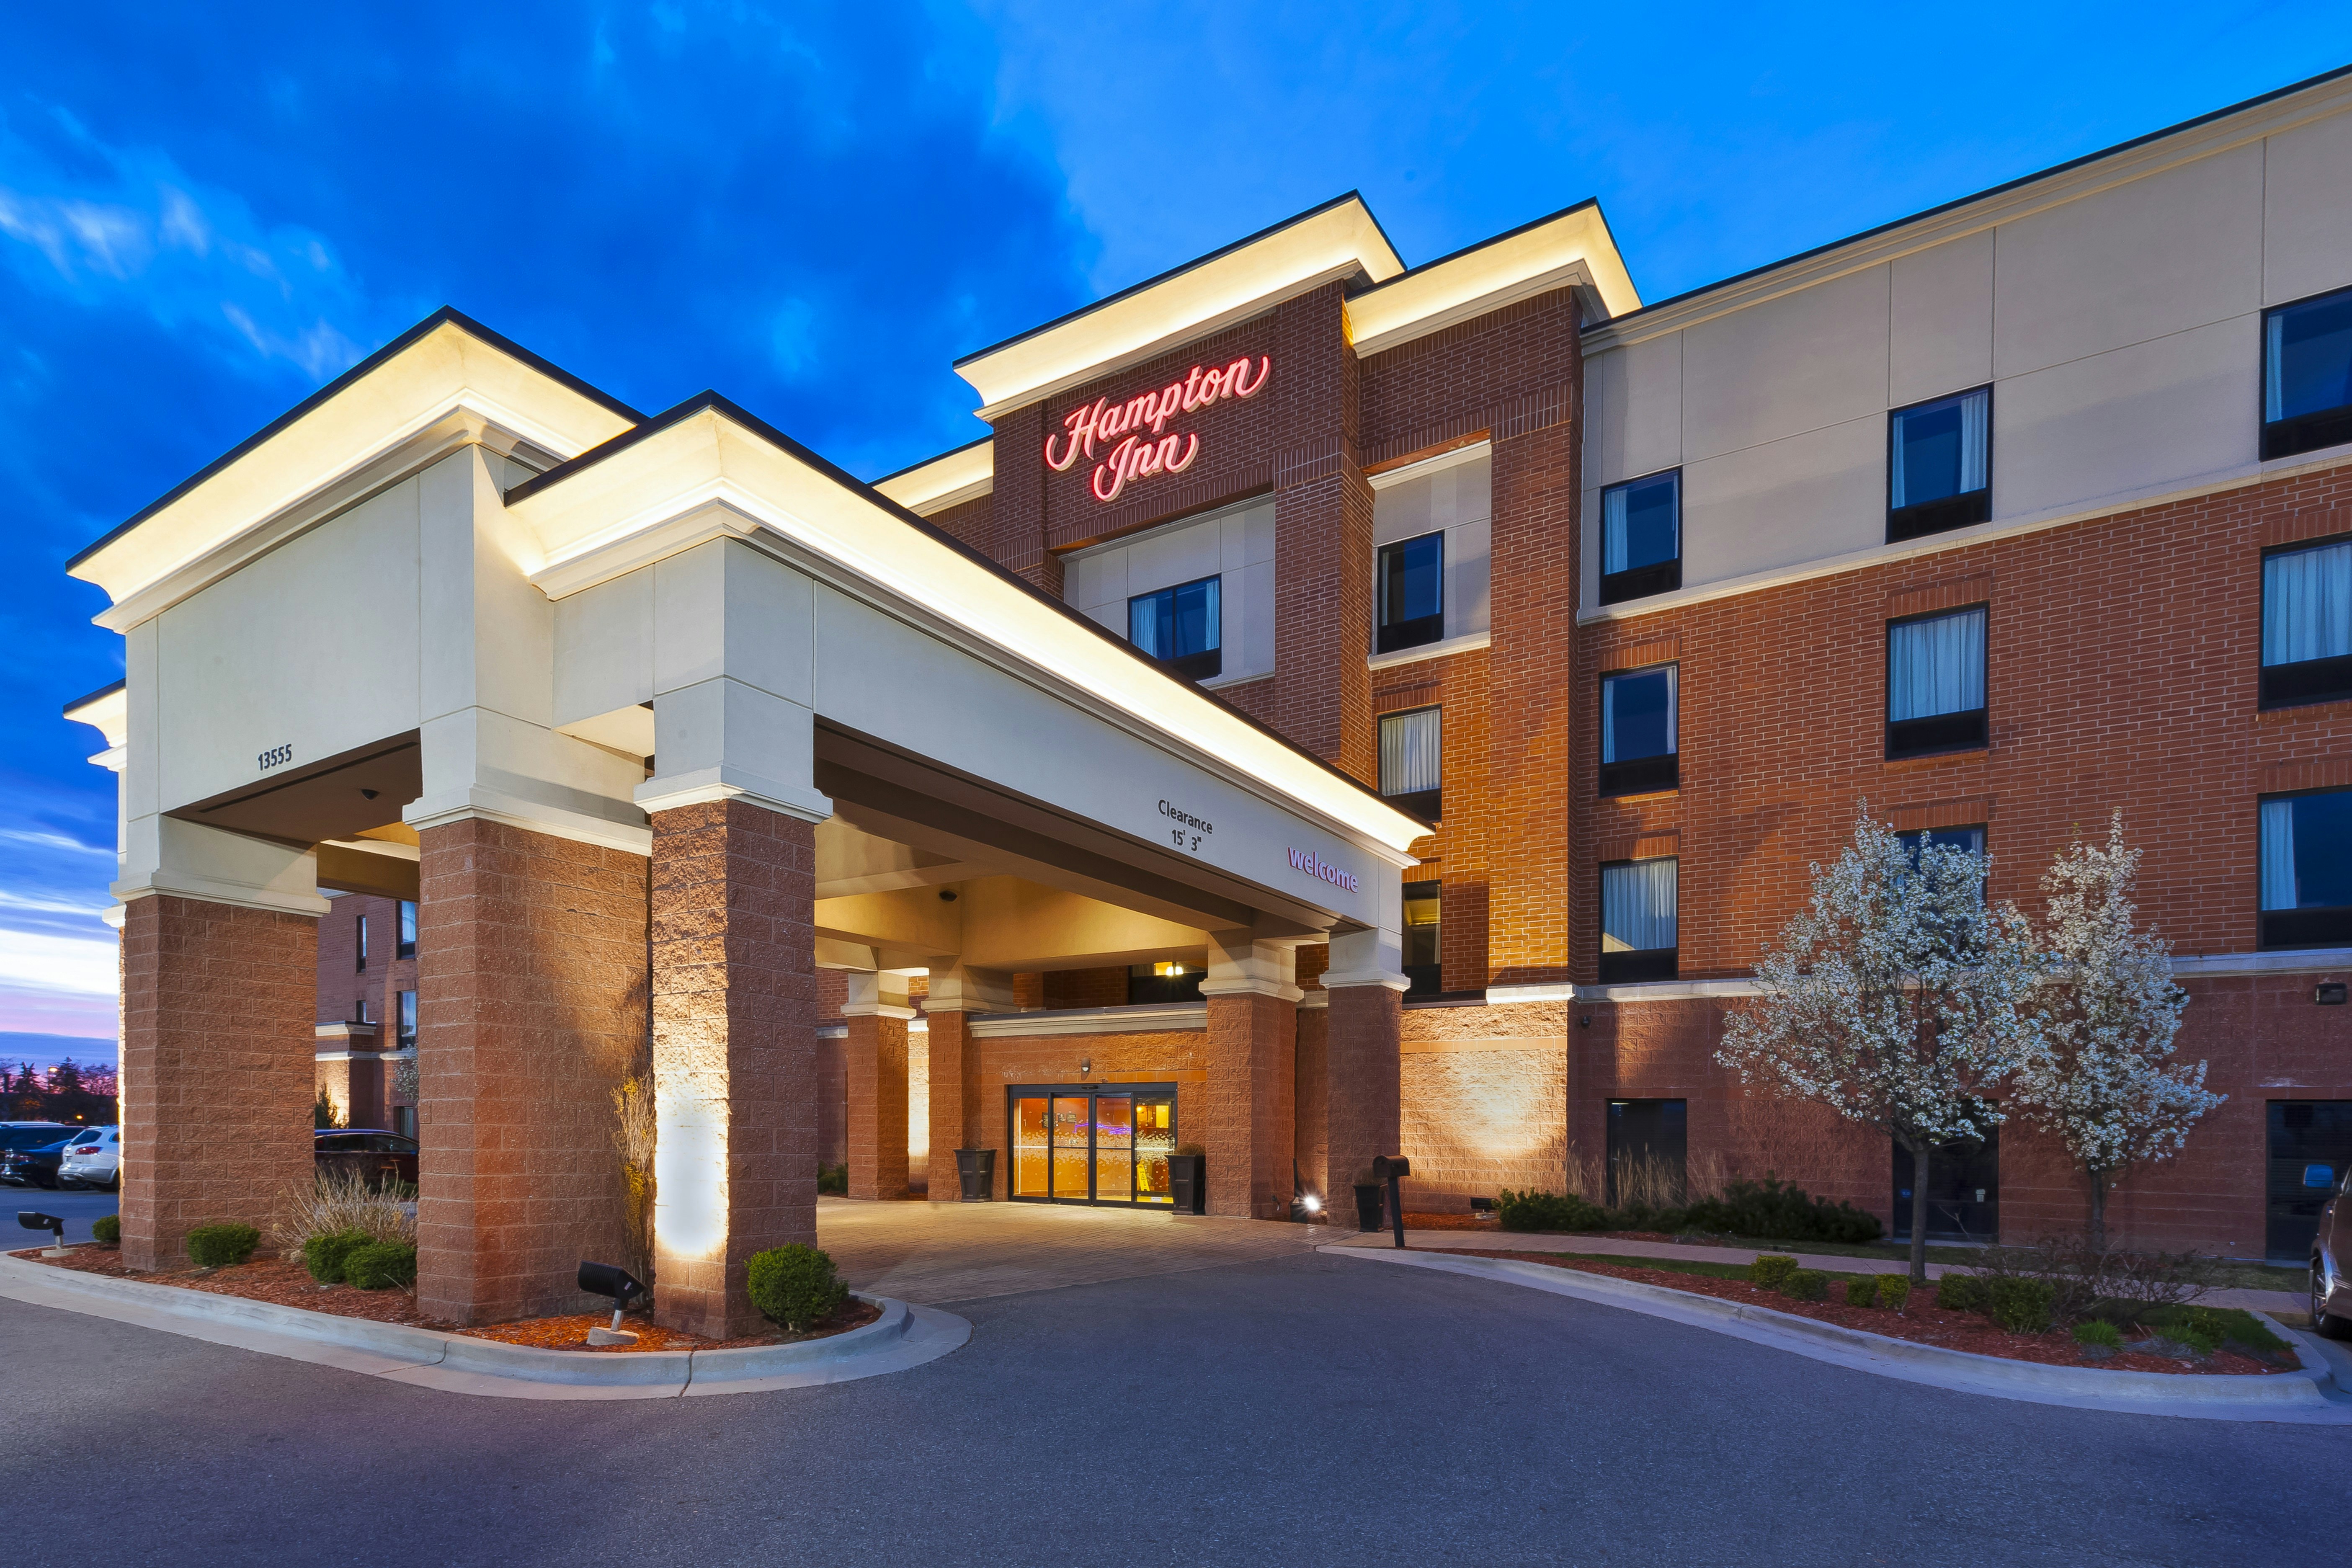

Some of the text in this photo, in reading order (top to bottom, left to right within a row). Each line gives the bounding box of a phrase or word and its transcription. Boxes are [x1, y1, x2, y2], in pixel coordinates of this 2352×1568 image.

[1046, 356, 1270, 471] Hampton
[1093, 433, 1199, 502] Inn
[258, 743, 291, 771] 13555
[1158, 799, 1213, 834] Clearance
[1287, 847, 1358, 893] welcome
